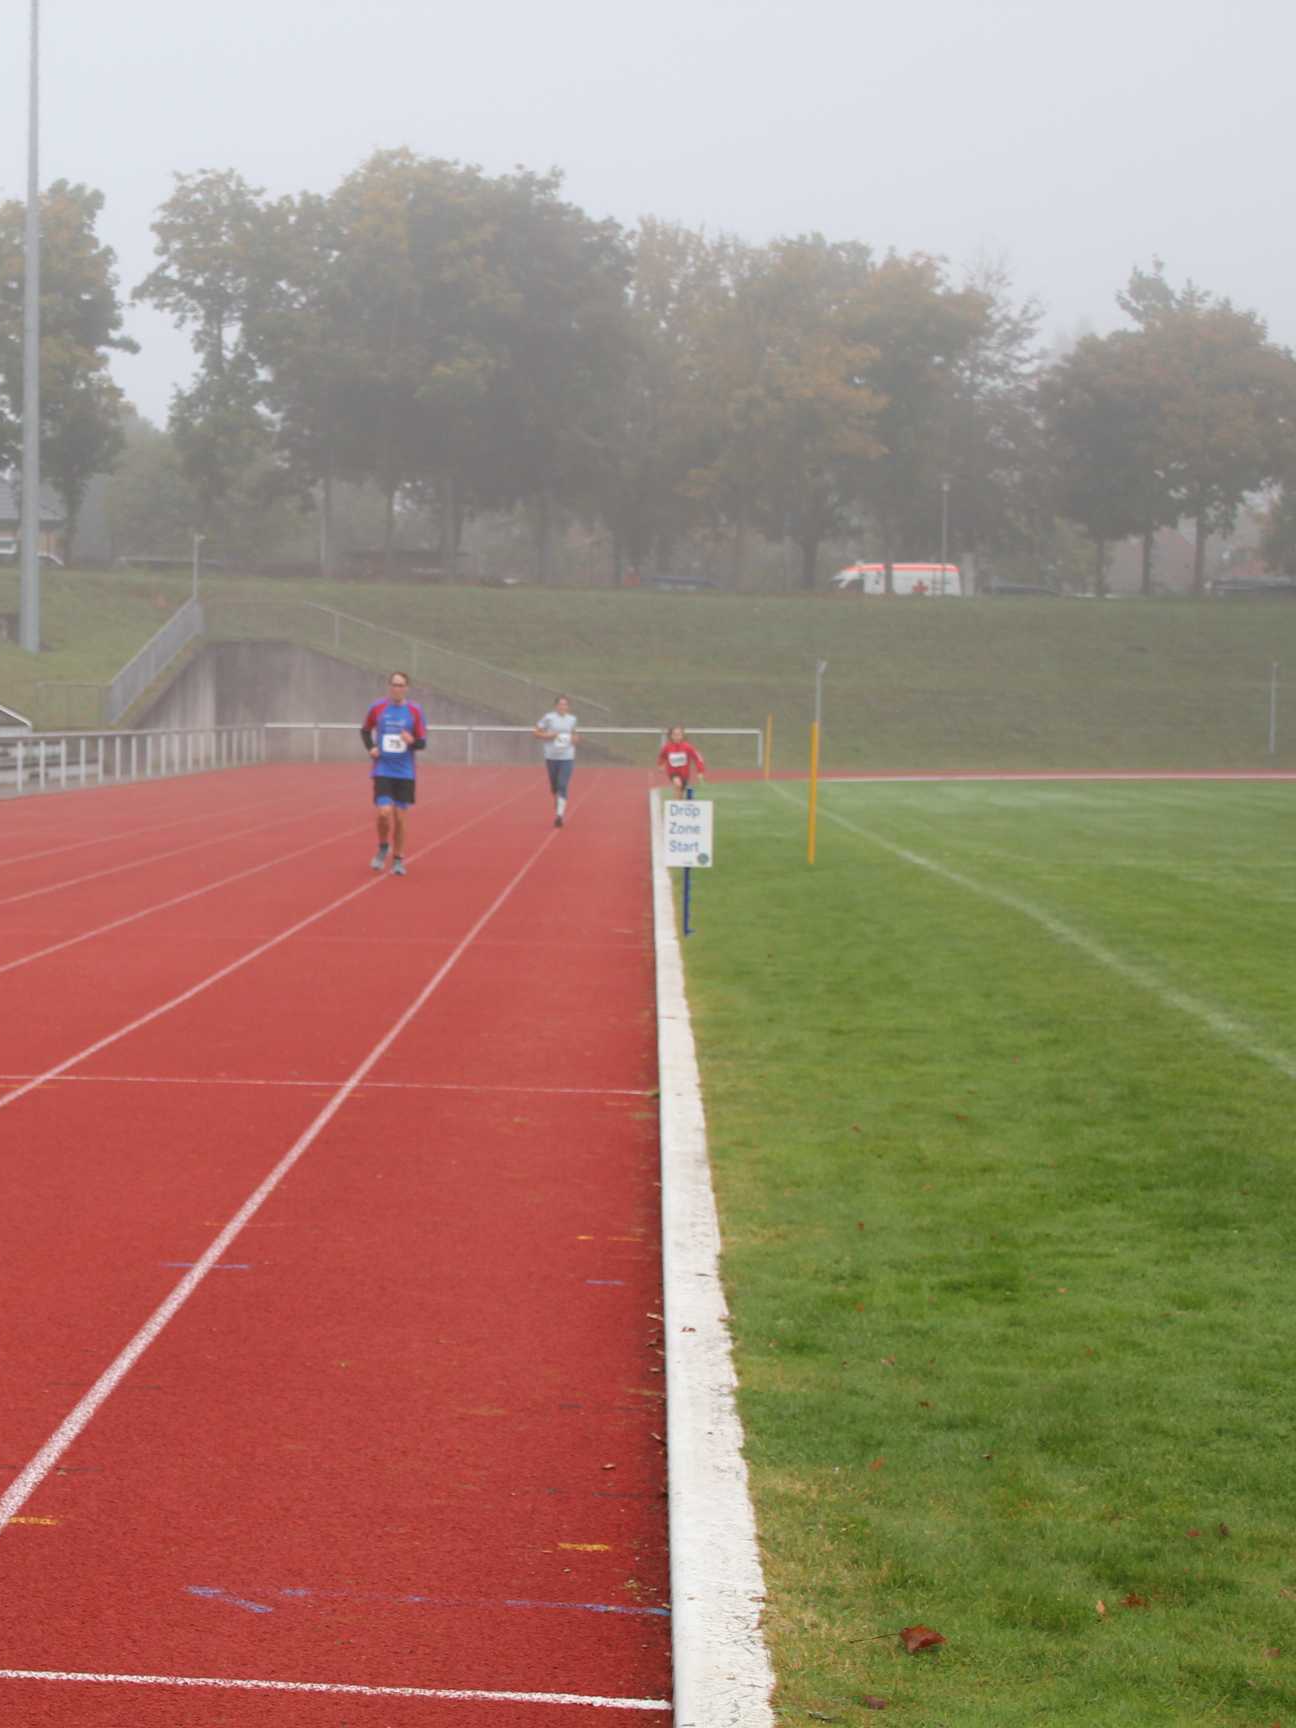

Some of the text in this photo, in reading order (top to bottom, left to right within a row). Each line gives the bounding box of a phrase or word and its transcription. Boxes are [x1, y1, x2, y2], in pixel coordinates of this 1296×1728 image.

[670, 804, 701, 818] Drop
[669, 822, 701, 834] Zone
[669, 840, 699, 852] Start
